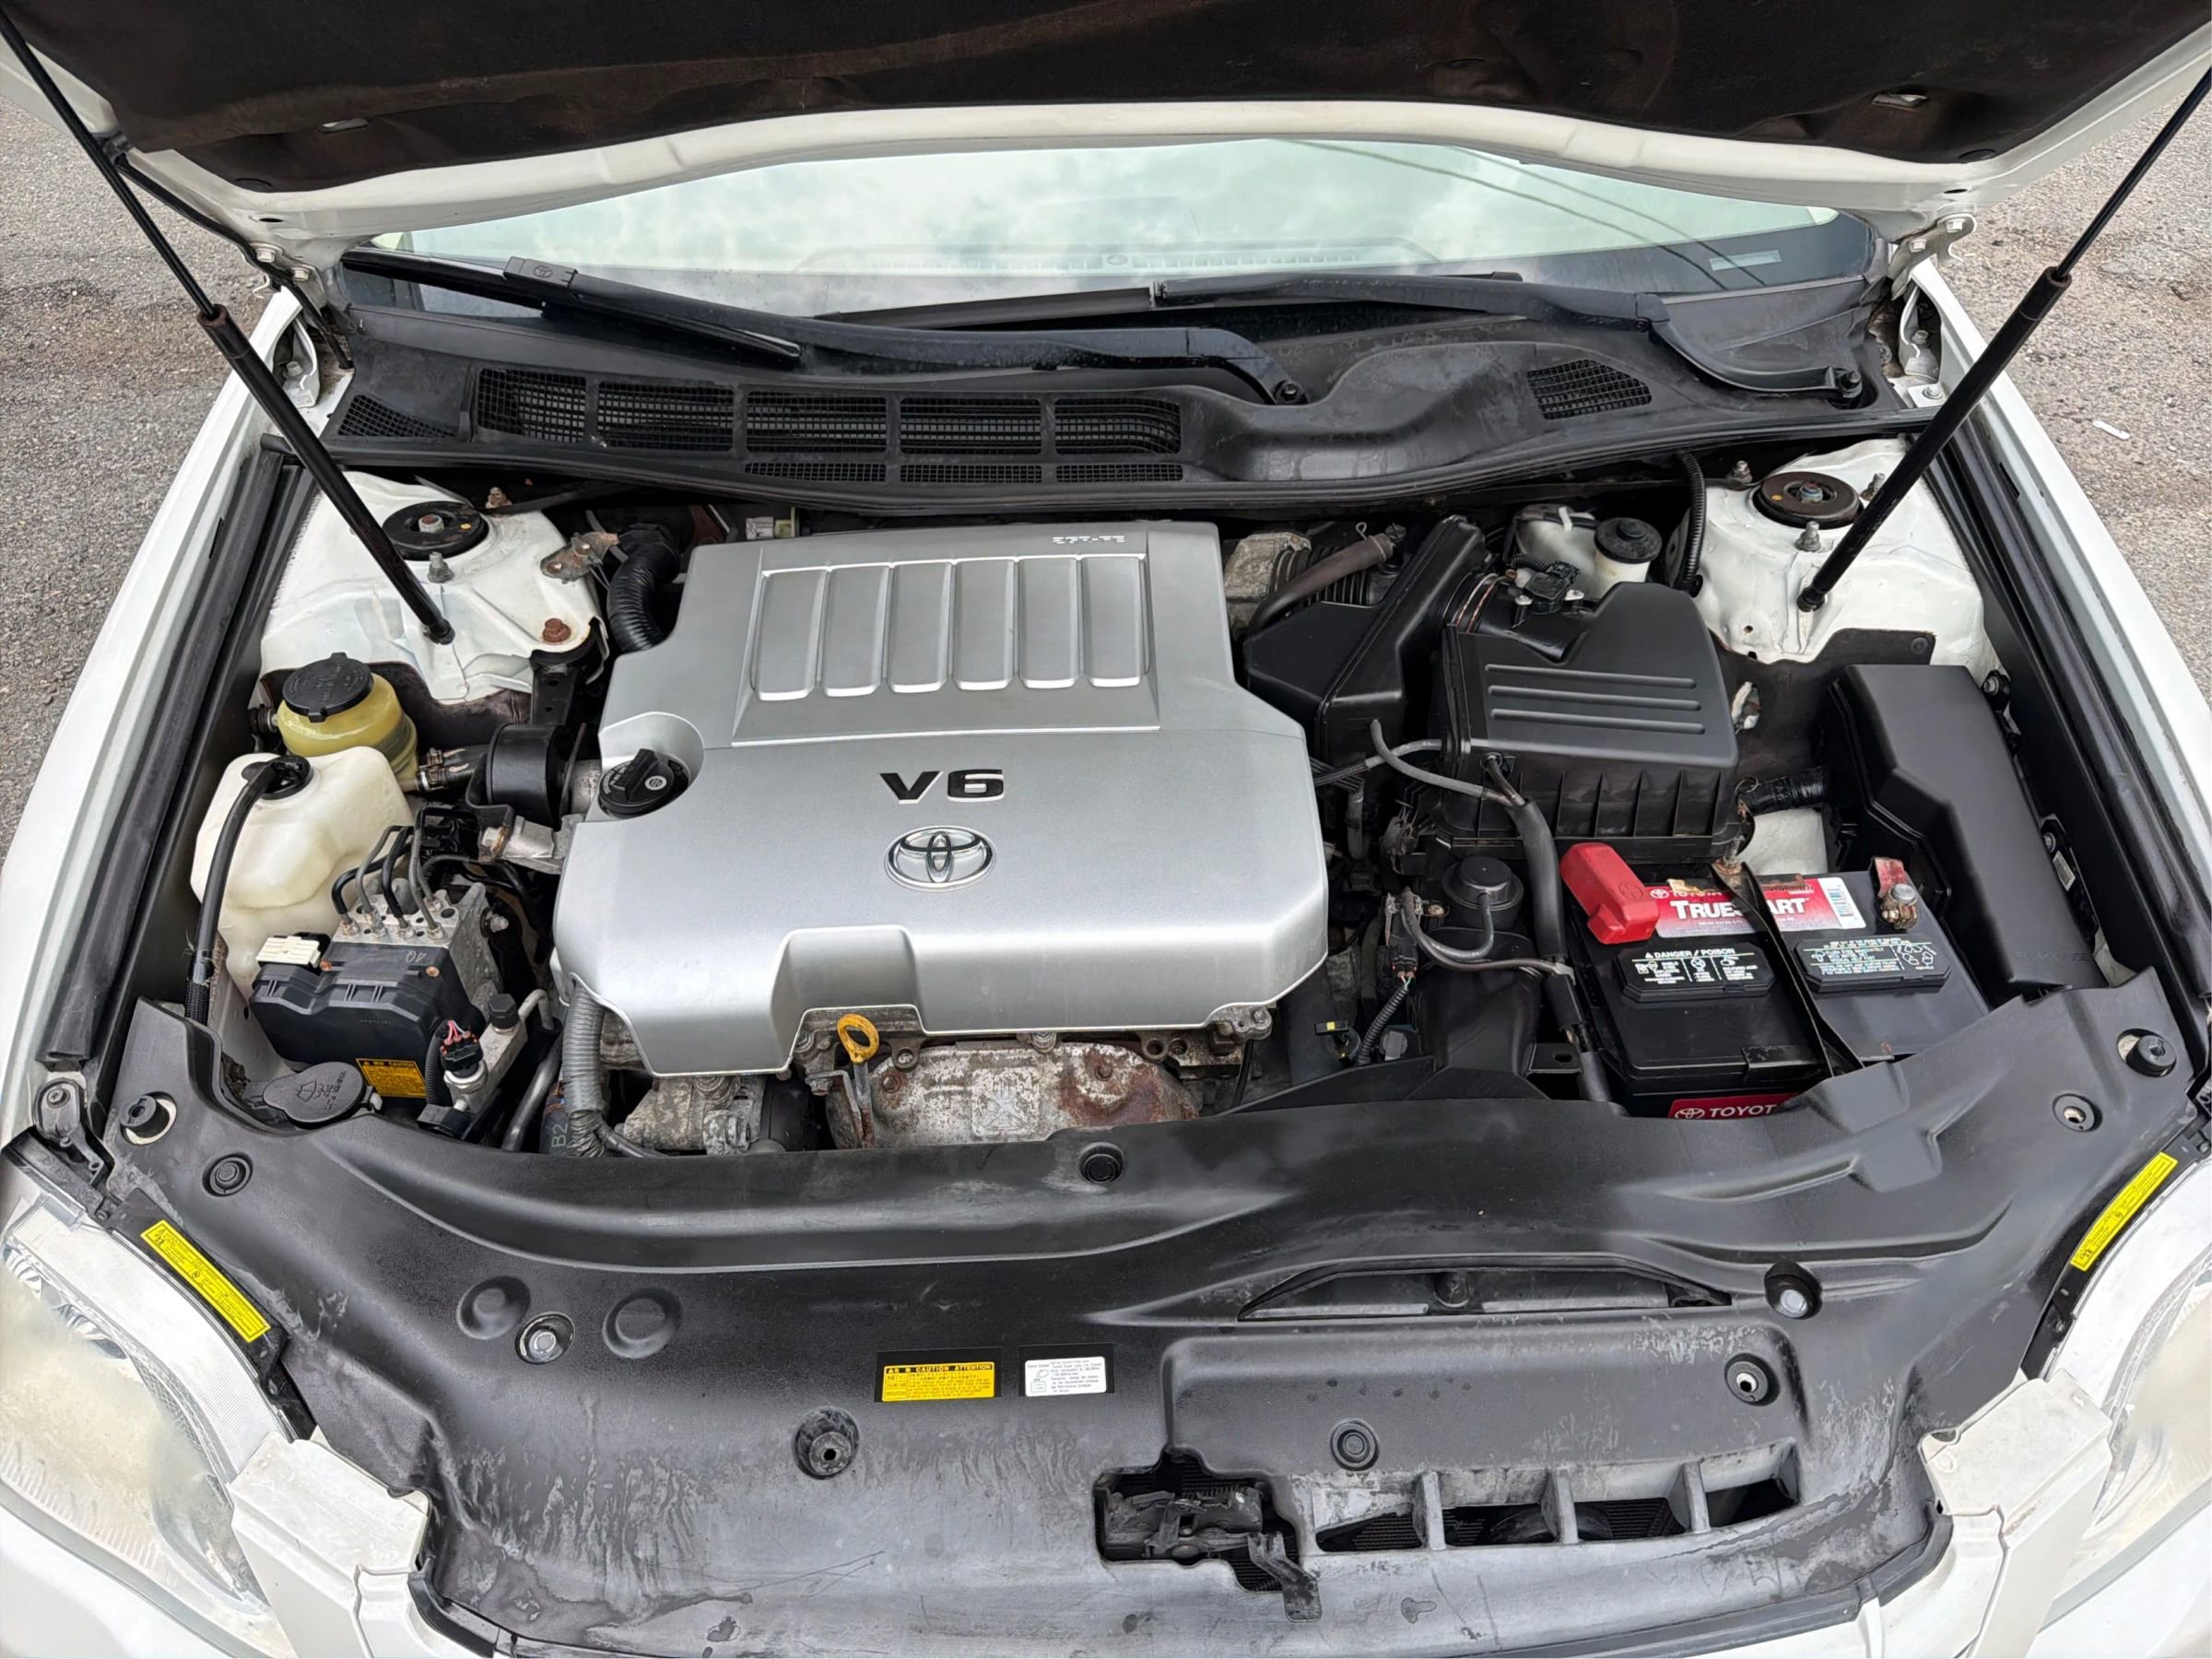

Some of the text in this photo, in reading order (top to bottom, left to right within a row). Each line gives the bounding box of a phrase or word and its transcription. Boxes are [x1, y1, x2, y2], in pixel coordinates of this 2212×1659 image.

[879, 769, 1005, 805] V6
[1653, 950, 1692, 959] DANGER
[1700, 947, 1735, 956] POISON
[1710, 1104, 1778, 1118] TOYOT
[551, 1124, 568, 1147] B2
